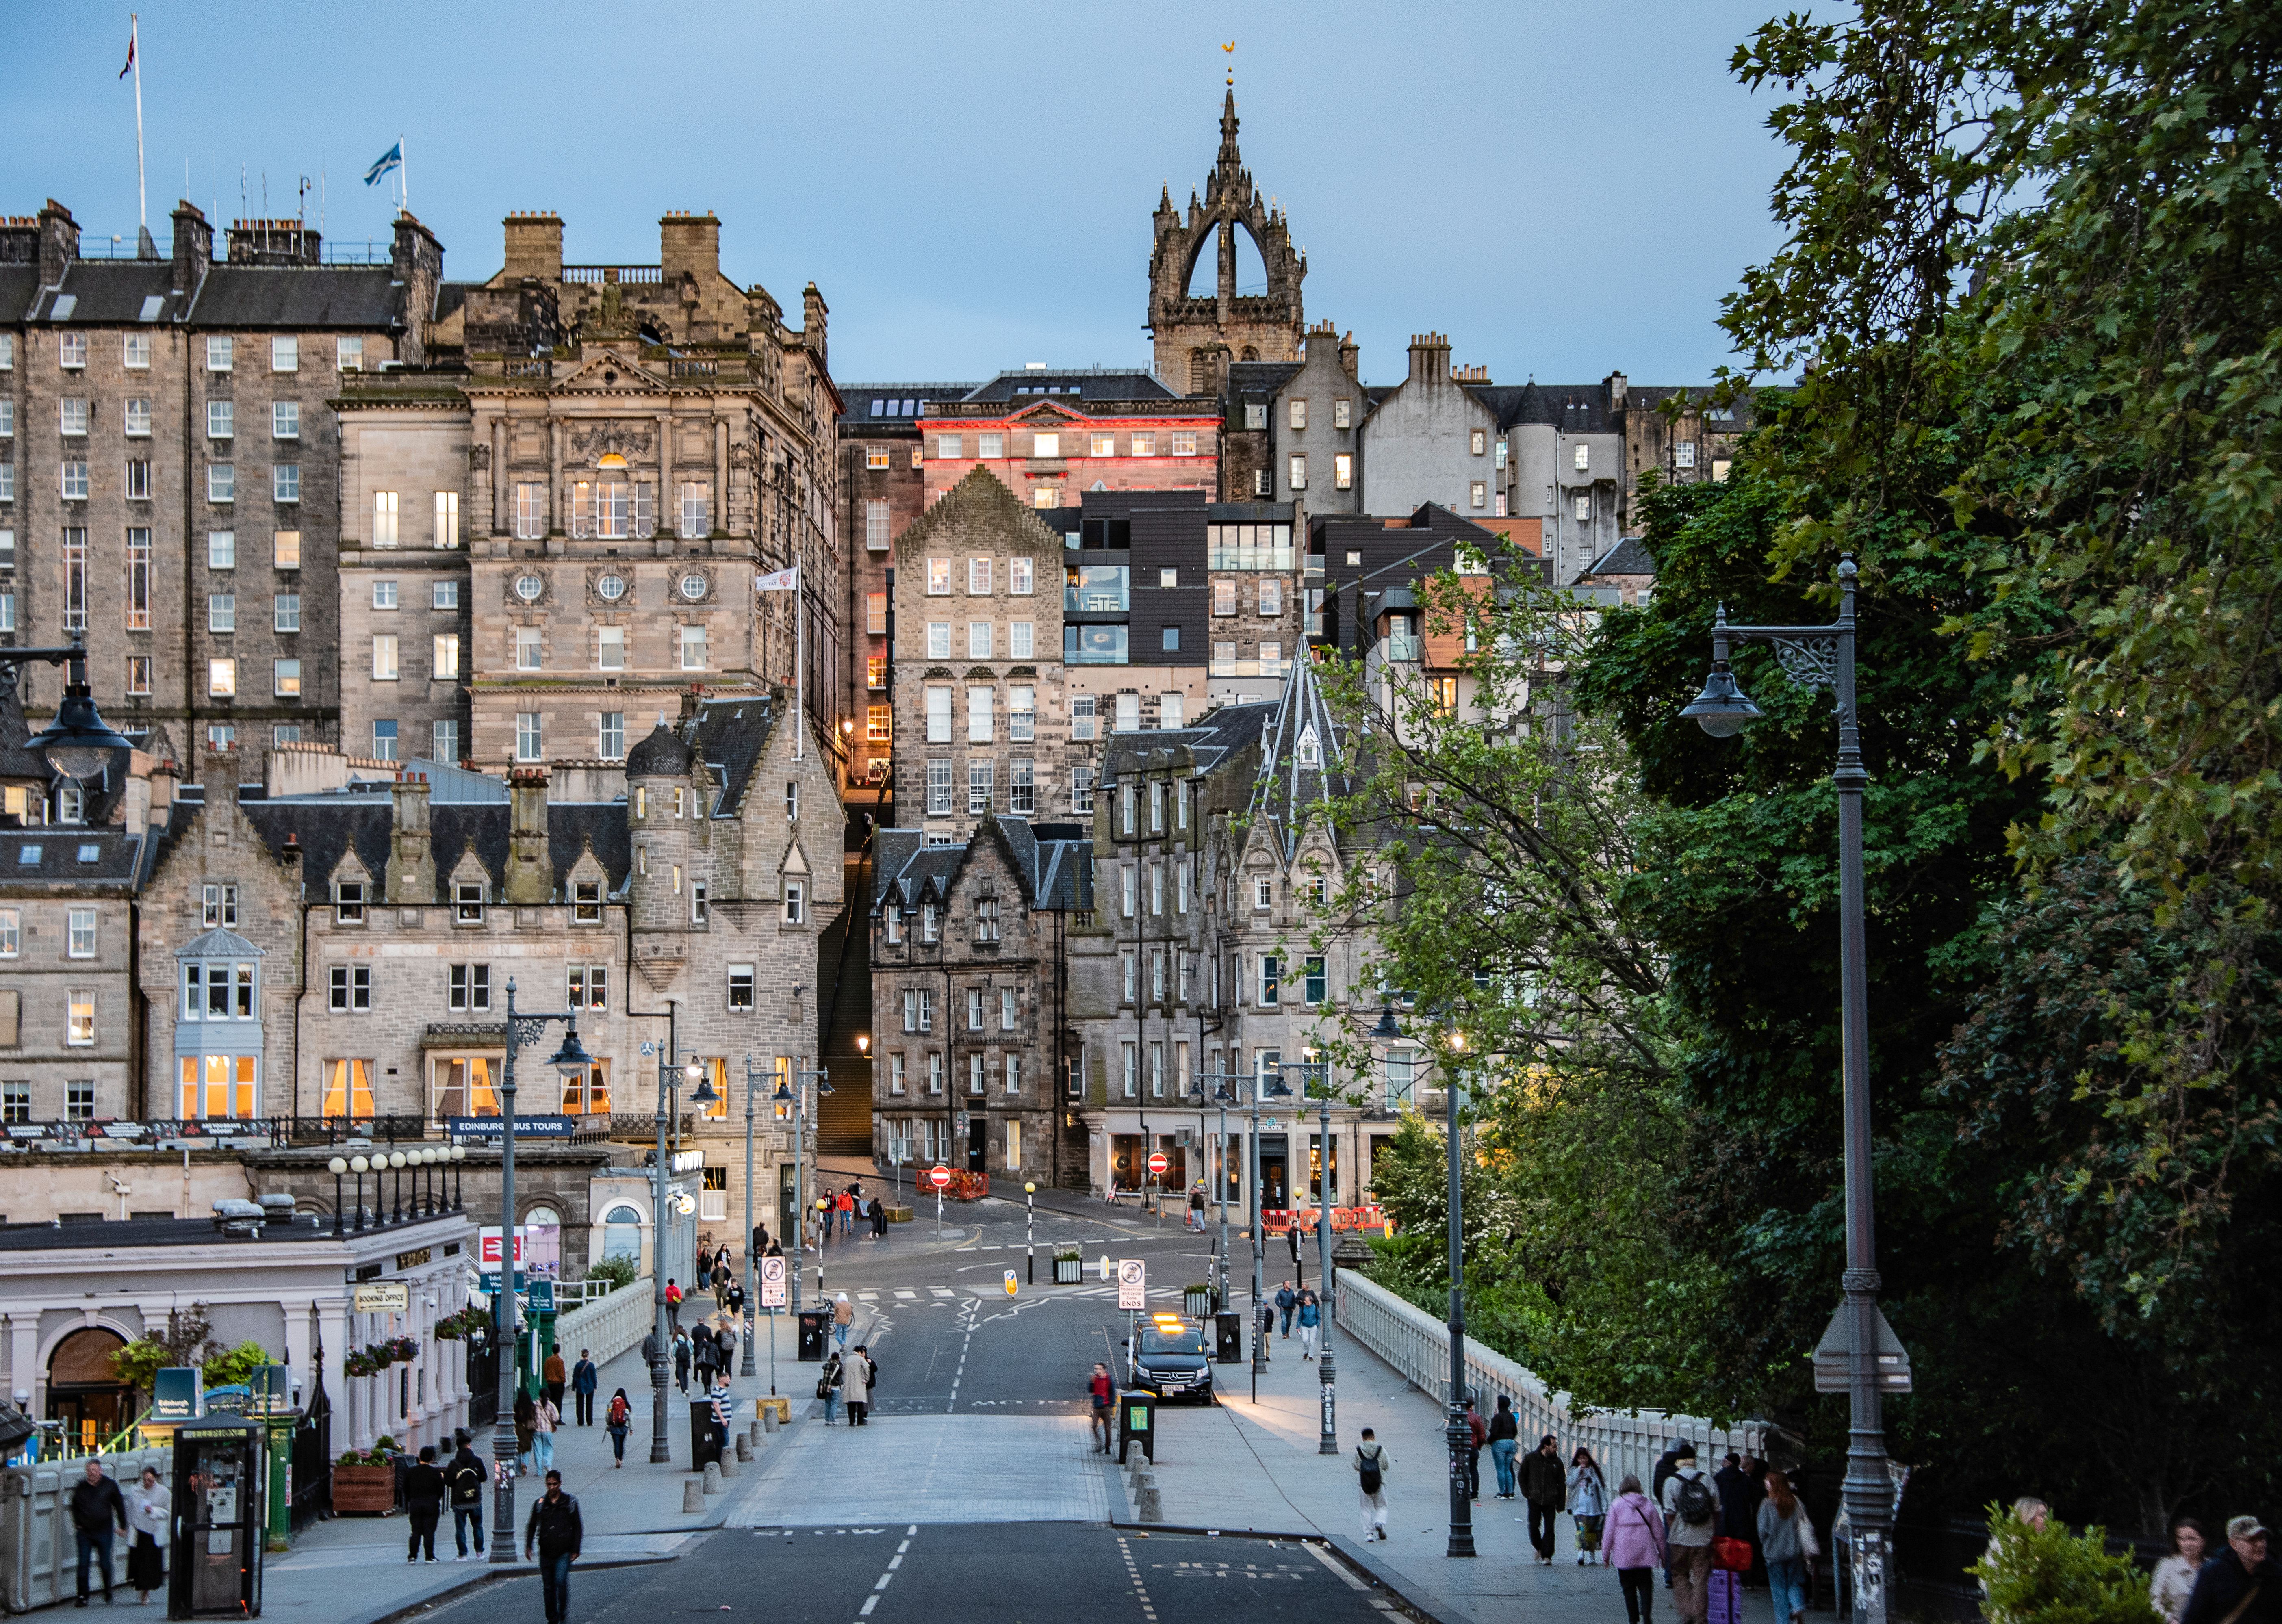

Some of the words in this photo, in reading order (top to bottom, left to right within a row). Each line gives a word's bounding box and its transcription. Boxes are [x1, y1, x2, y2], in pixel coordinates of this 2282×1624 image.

[459, 1122, 504, 1130] EDINBURG
[513, 1122, 531, 1130] BUS
[533, 1122, 563, 1130] TOURS
[158, 1399, 189, 1407] Edinburgh
[160, 1407, 189, 1415] Waverley
